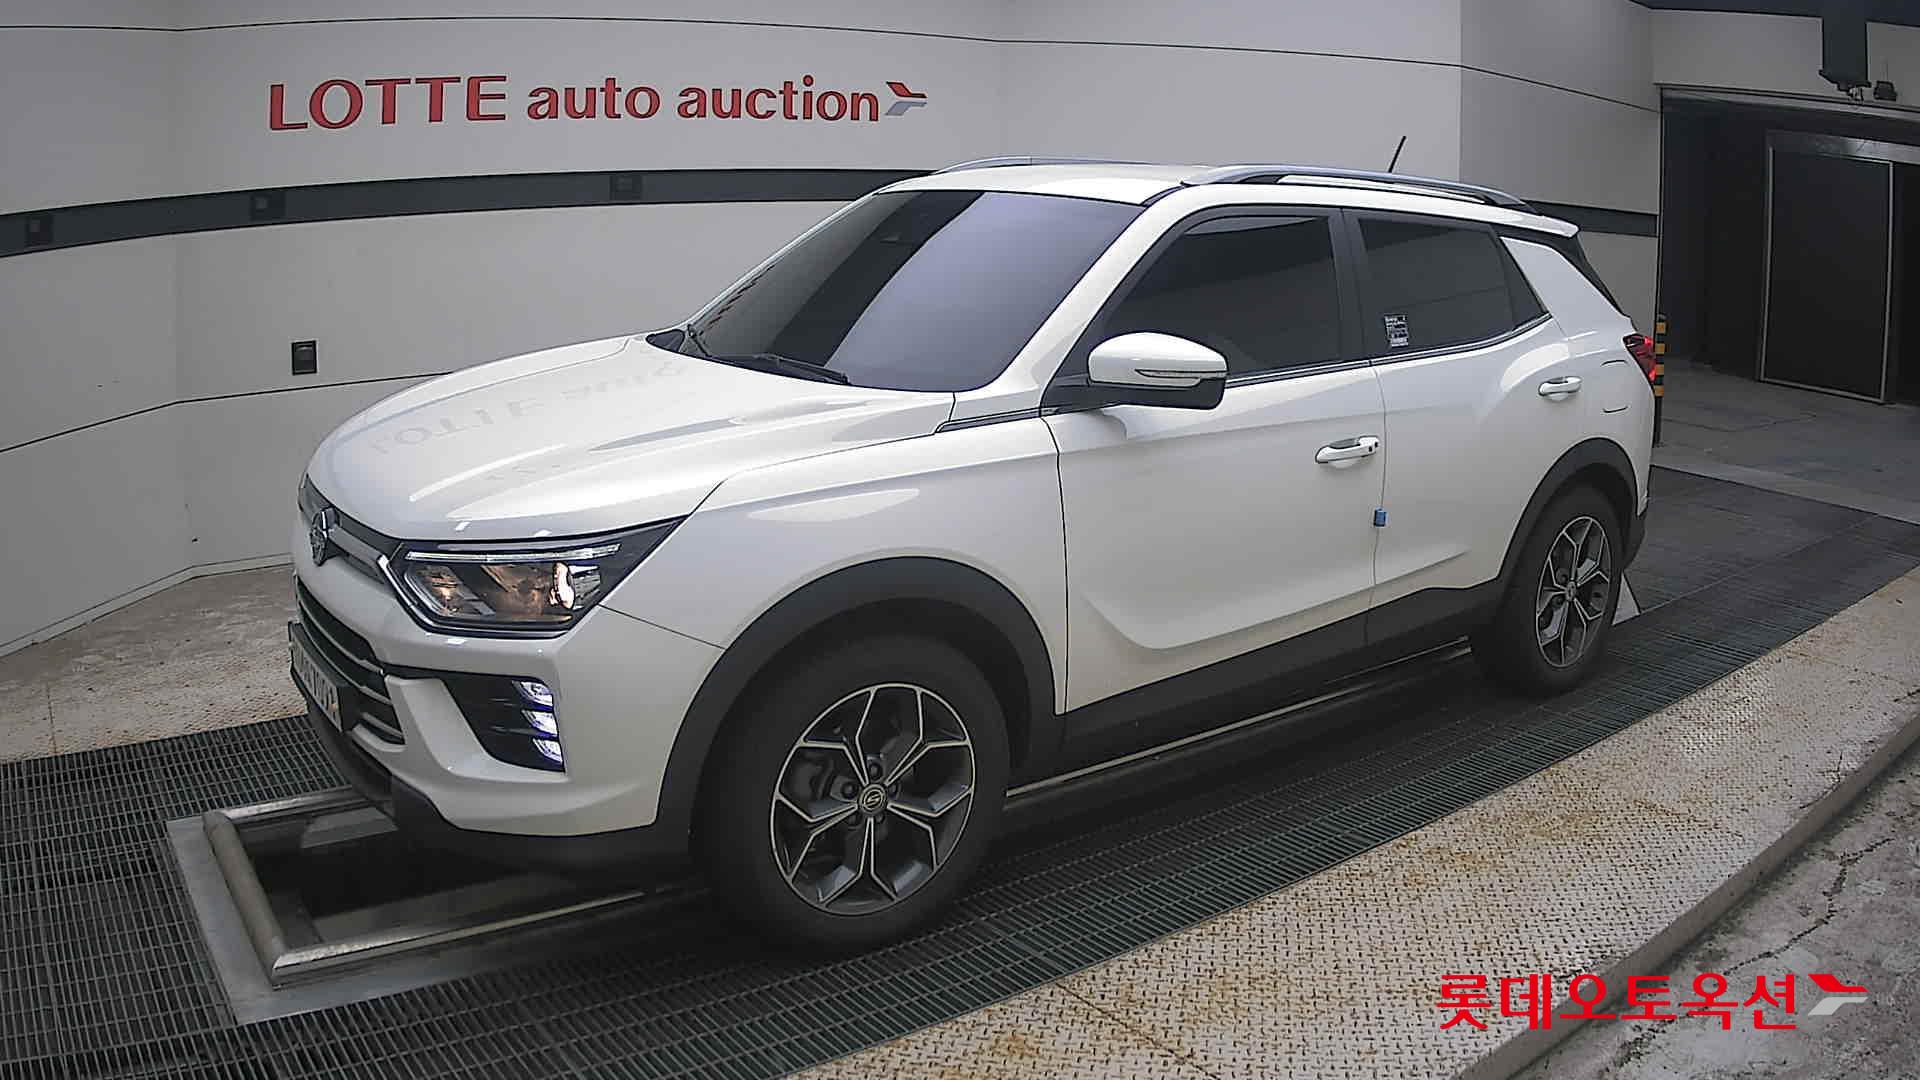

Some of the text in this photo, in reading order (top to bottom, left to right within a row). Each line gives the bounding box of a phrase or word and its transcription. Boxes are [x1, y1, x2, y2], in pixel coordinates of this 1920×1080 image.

[270, 76, 879, 130] LOTTE auto auction
